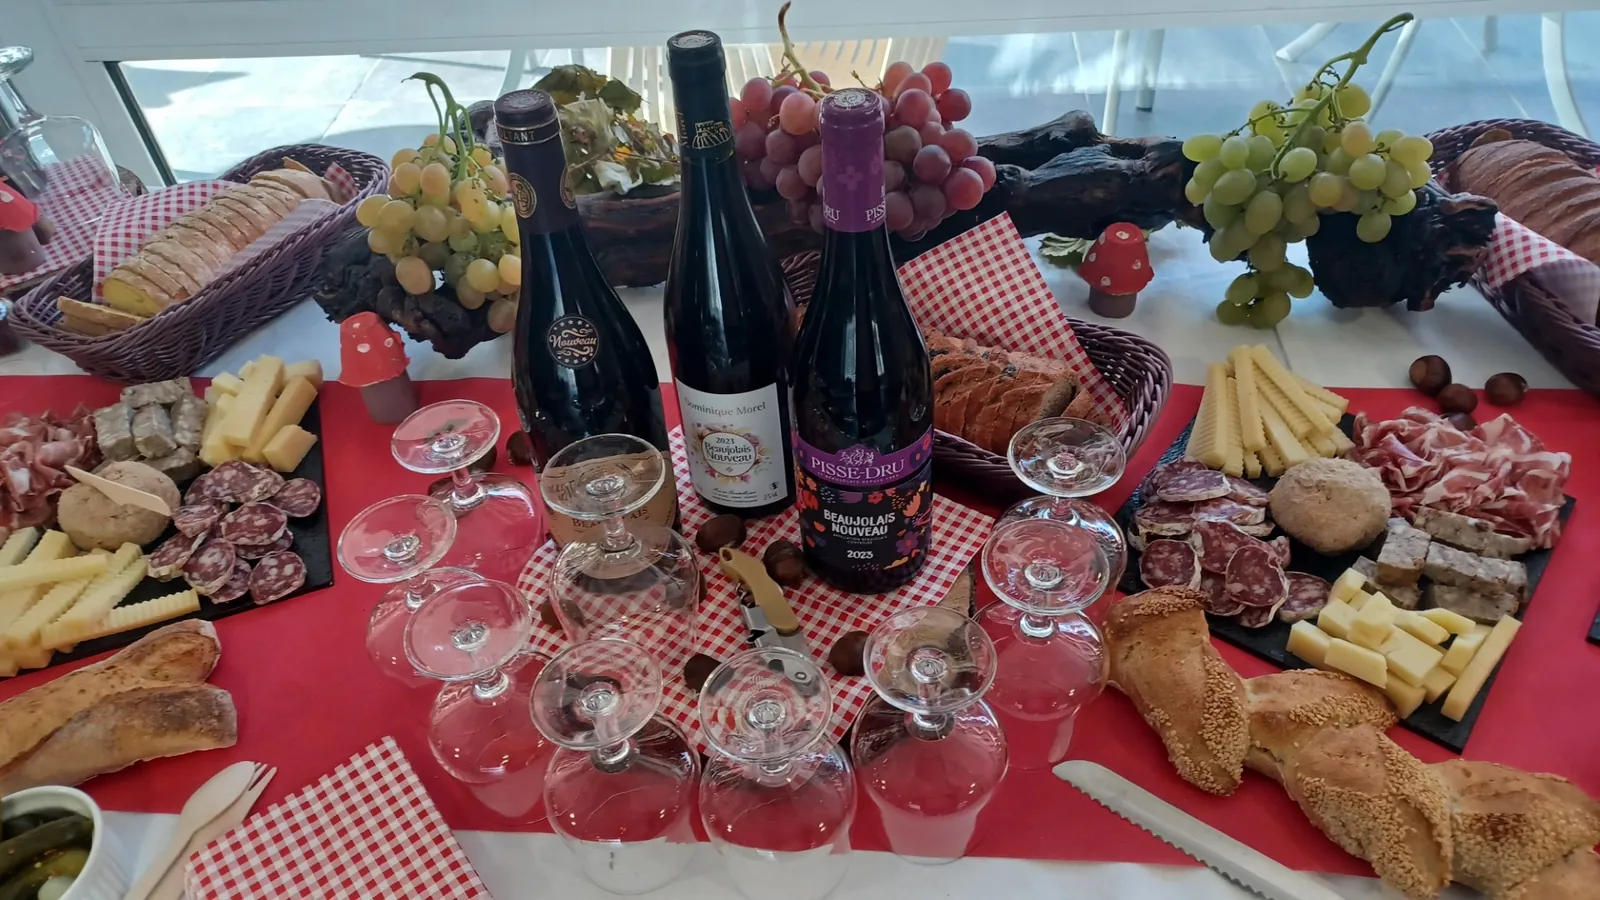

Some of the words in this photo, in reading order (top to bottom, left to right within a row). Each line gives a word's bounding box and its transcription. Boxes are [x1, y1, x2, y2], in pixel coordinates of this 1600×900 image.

[549, 335, 597, 348] Nouveau
[683, 396, 734, 417] Dominique
[736, 401, 766, 415] Morel
[716, 436, 735, 444] 2023
[704, 441, 752, 455] Beaujolais
[708, 450, 752, 462] Nouveau
[811, 456, 906, 479] PISSE-DRU
[823, 508, 896, 527] BEAUJOLAIS
[831, 522, 888, 537] NOUVEAU
[847, 550, 874, 559] 2023
